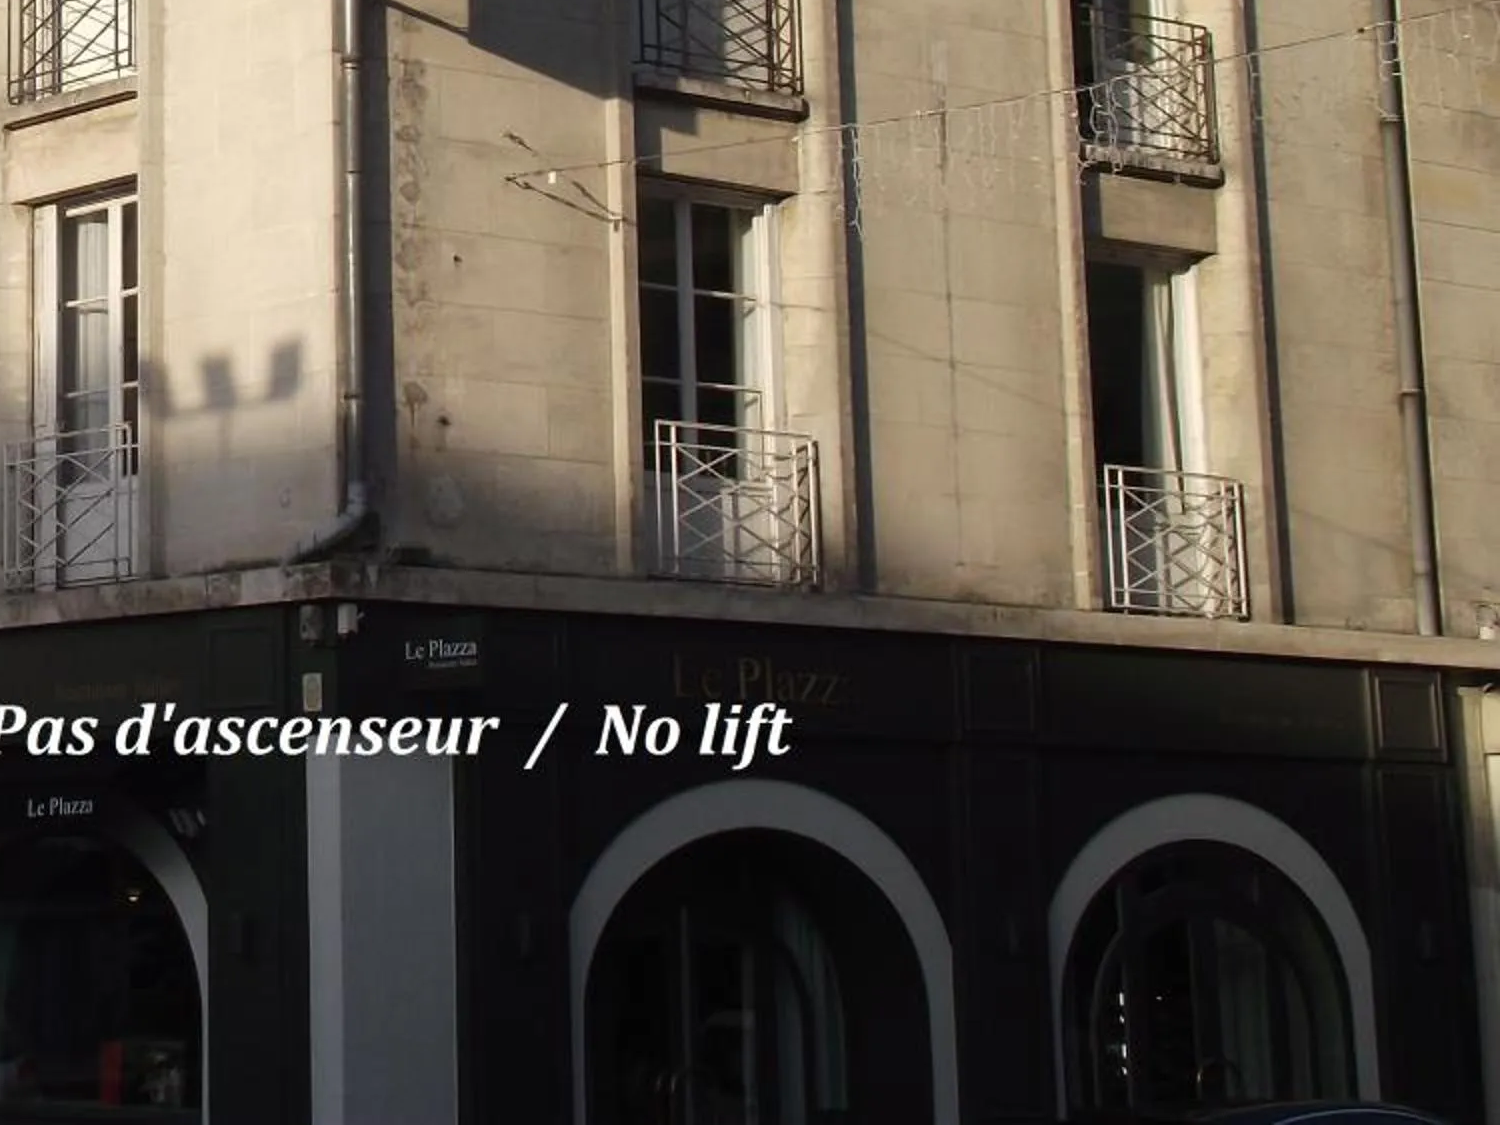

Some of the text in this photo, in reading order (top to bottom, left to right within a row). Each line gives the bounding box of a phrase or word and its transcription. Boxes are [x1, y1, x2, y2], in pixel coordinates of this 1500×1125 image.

[403, 638, 477, 660] Le Plazza
[27, 796, 93, 818] Le Plazza
